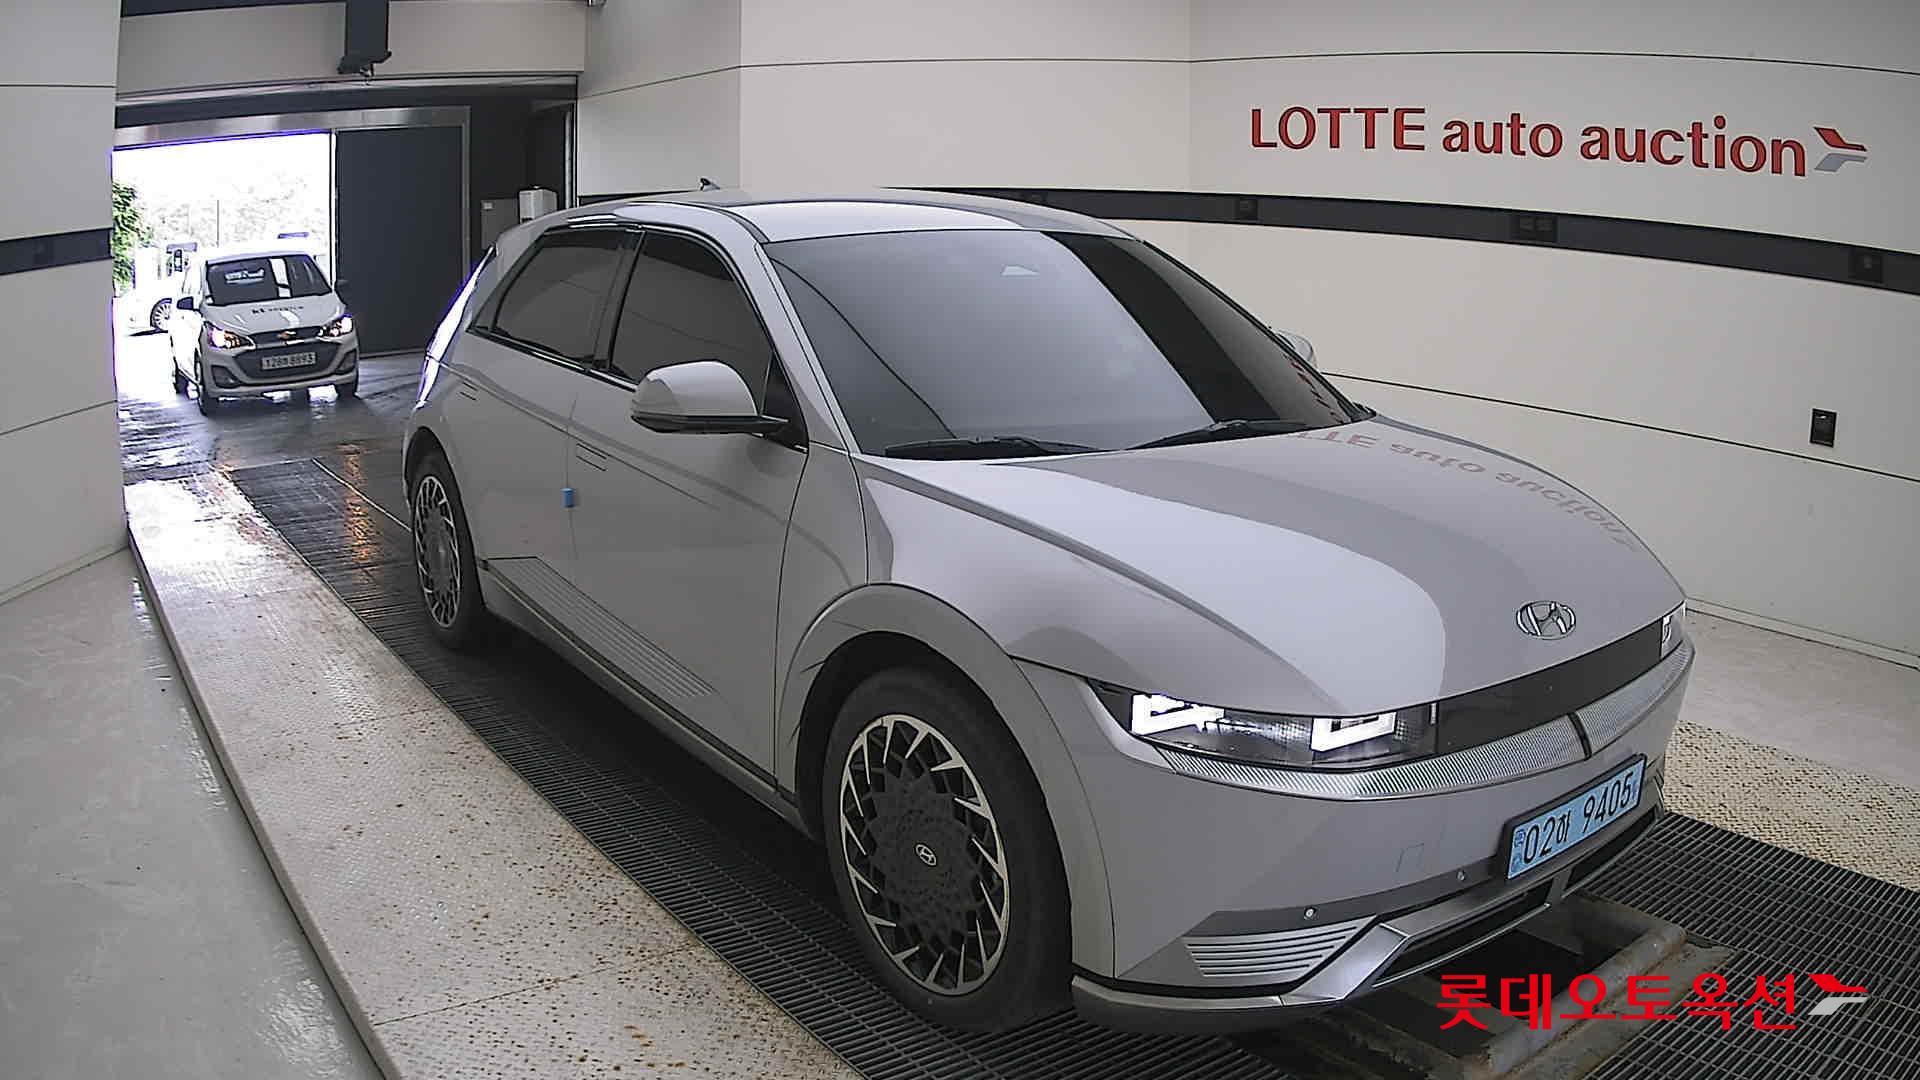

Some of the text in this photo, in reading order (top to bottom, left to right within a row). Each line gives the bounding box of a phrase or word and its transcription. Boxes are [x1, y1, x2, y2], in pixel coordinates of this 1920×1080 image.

[1251, 106, 1806, 177] LOTTE auto auction
[1582, 771, 1634, 834] 9405
